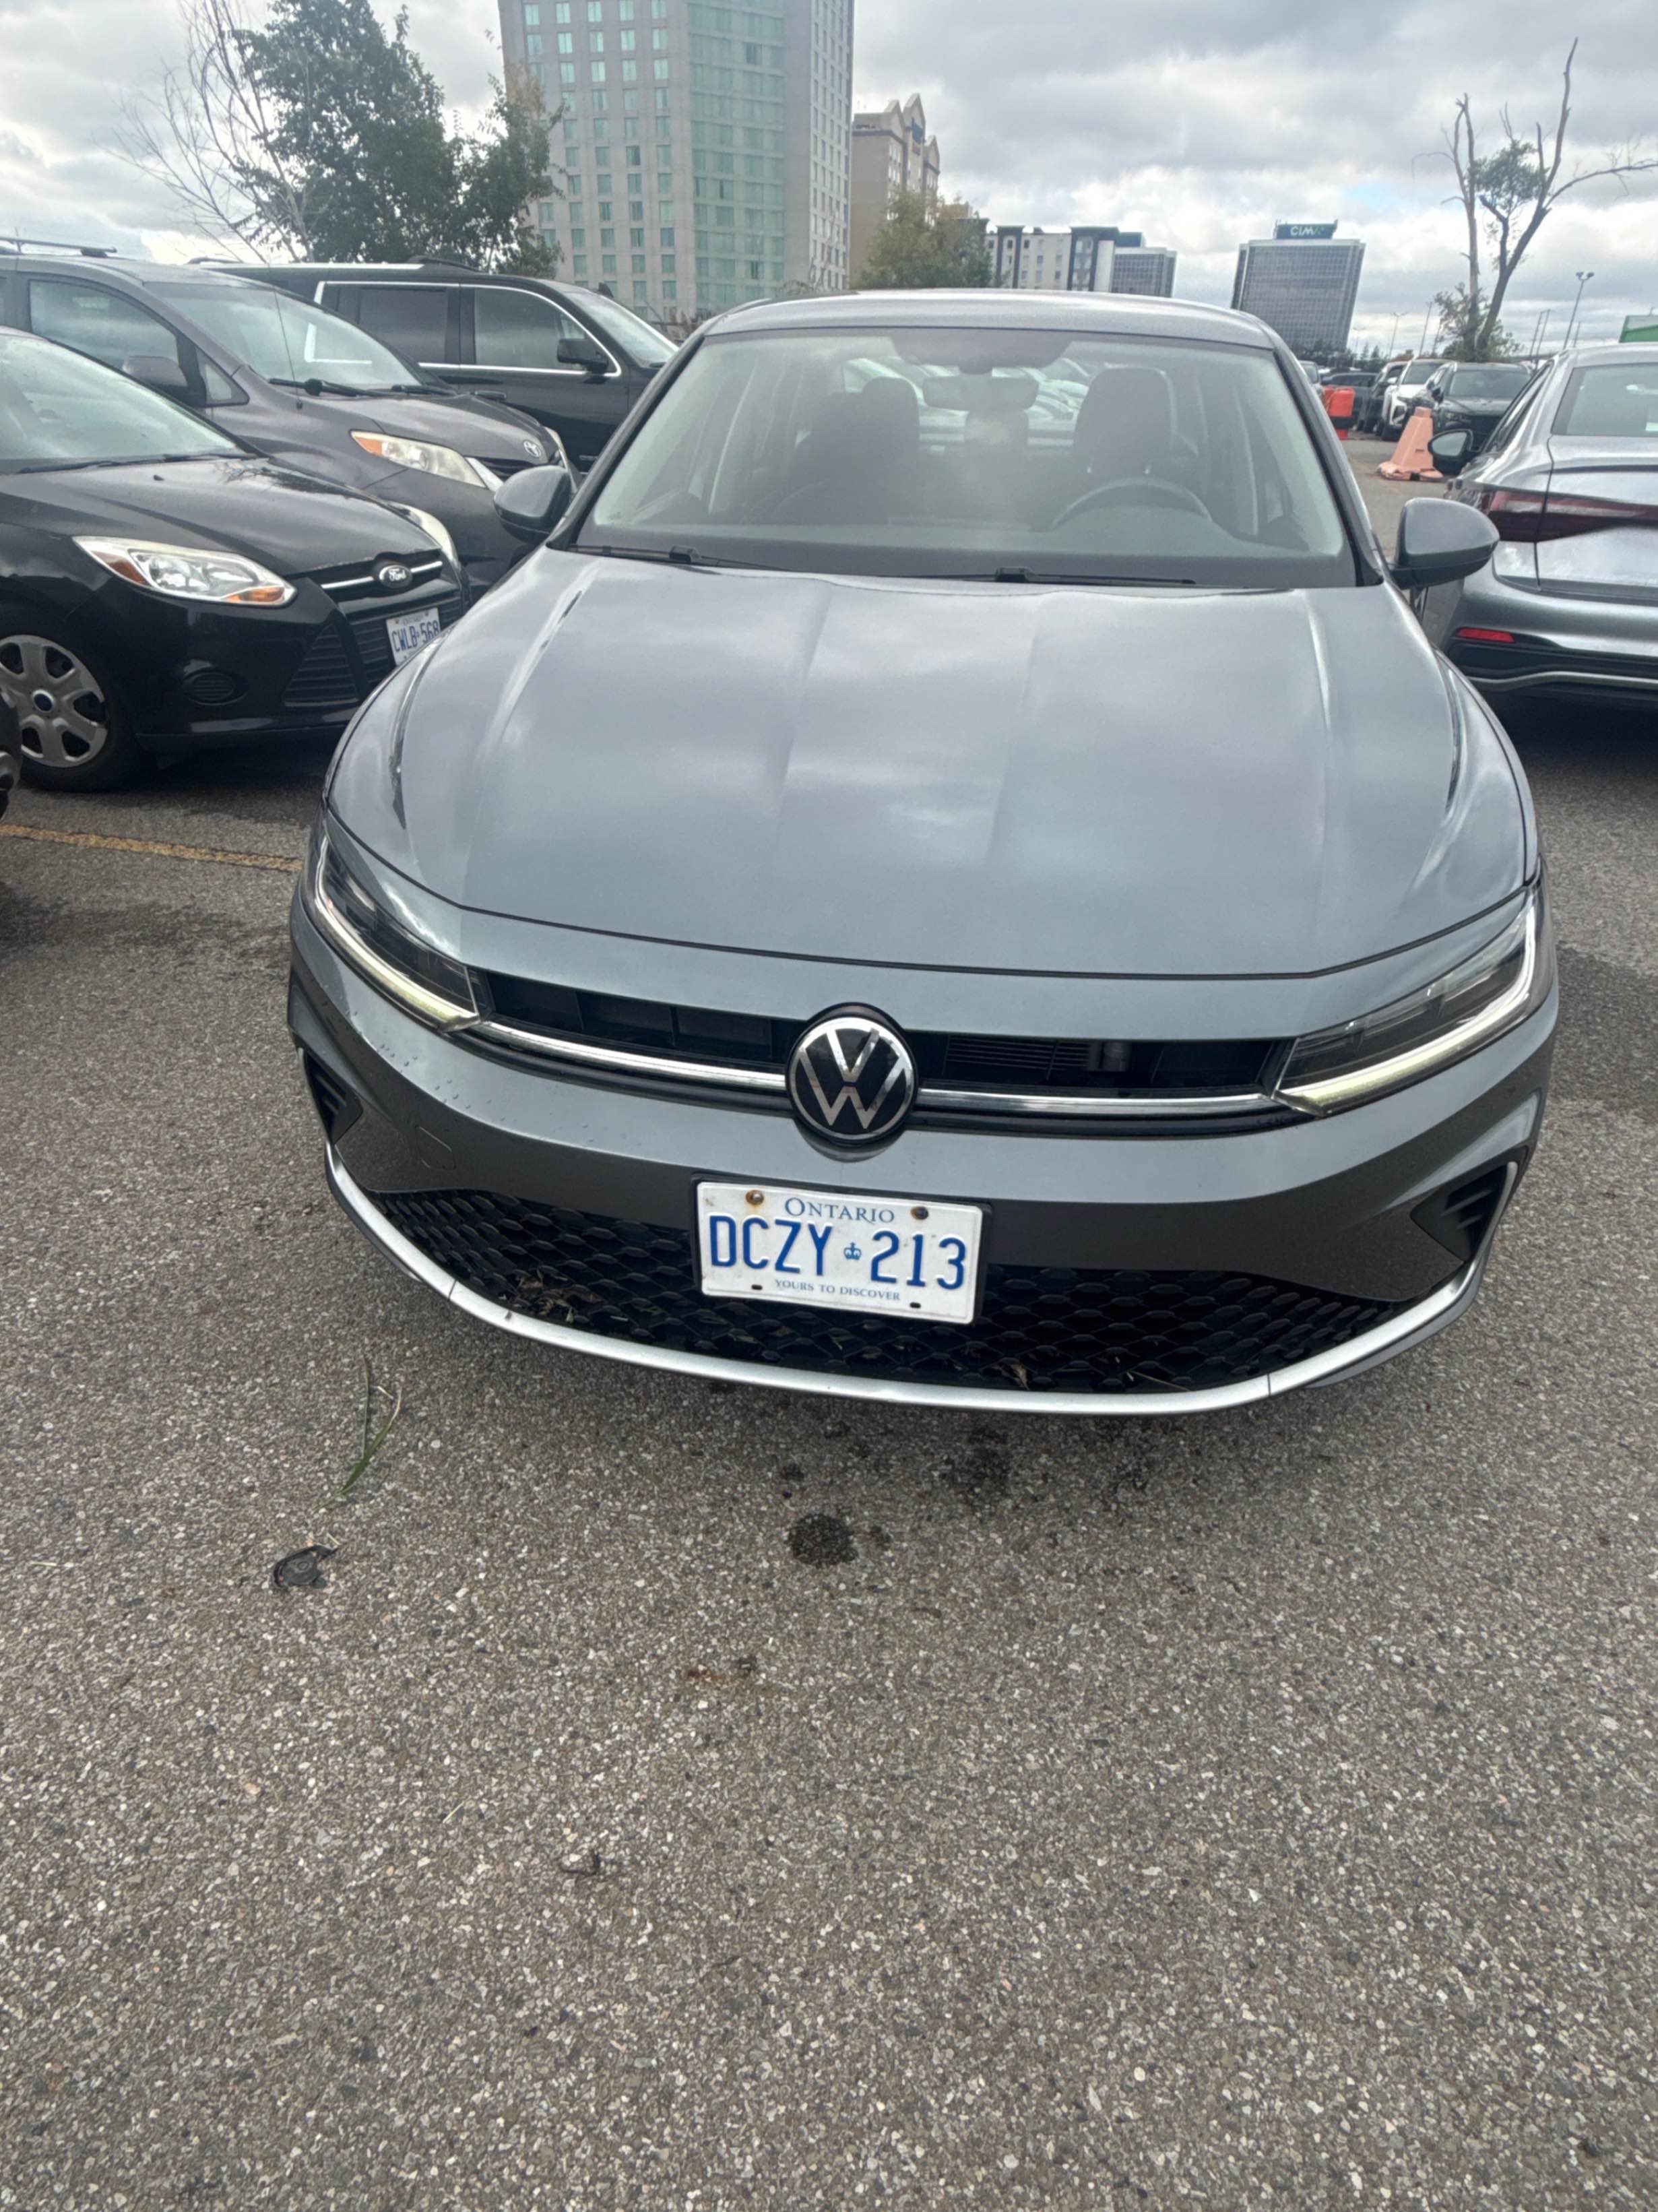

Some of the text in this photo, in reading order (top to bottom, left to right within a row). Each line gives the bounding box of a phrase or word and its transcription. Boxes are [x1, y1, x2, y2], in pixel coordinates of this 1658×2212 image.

[391, 620, 439, 652] CWLB 568
[784, 1197, 894, 1224] ONTARIO
[709, 1215, 966, 1290] DCZY 213
[775, 1279, 900, 1301] YOURS TO DISCOVER
